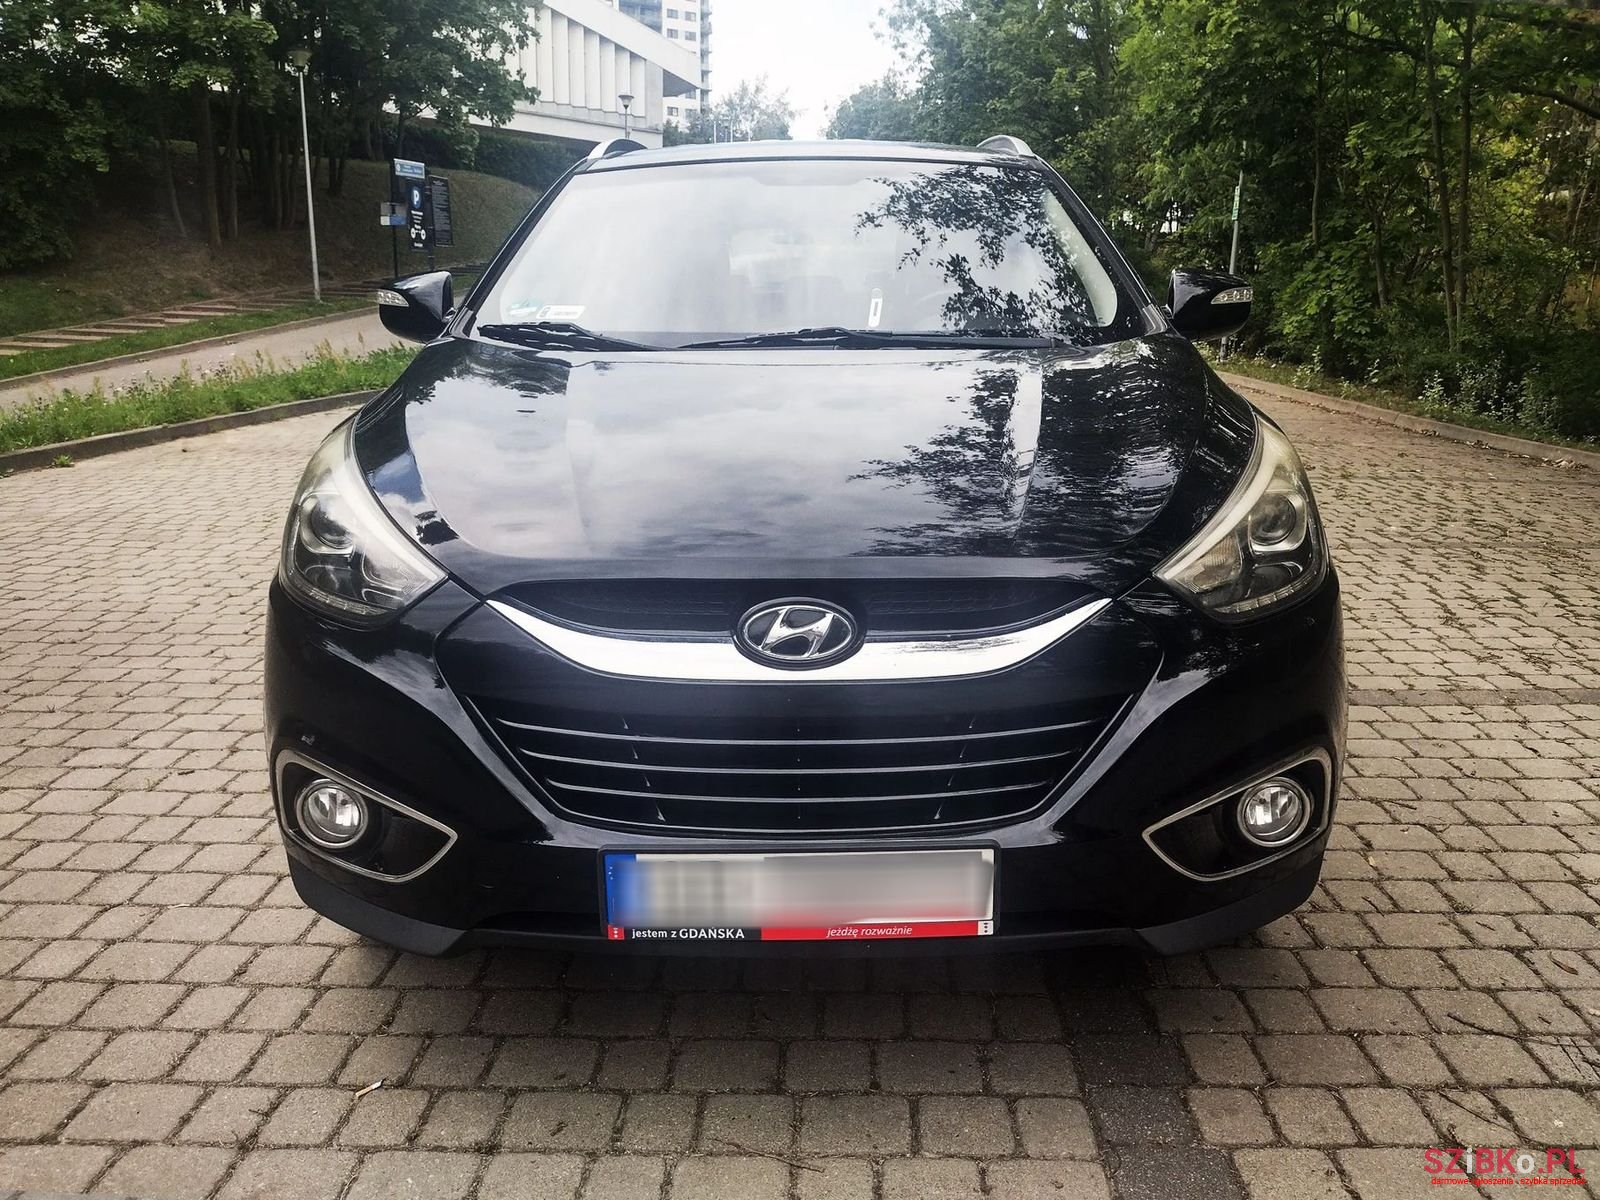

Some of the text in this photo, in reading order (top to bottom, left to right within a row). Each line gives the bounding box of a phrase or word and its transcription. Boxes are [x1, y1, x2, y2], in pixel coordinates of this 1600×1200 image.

[413, 190, 420, 205] P
[631, 926, 745, 939] jestem z GDAŃSKA
